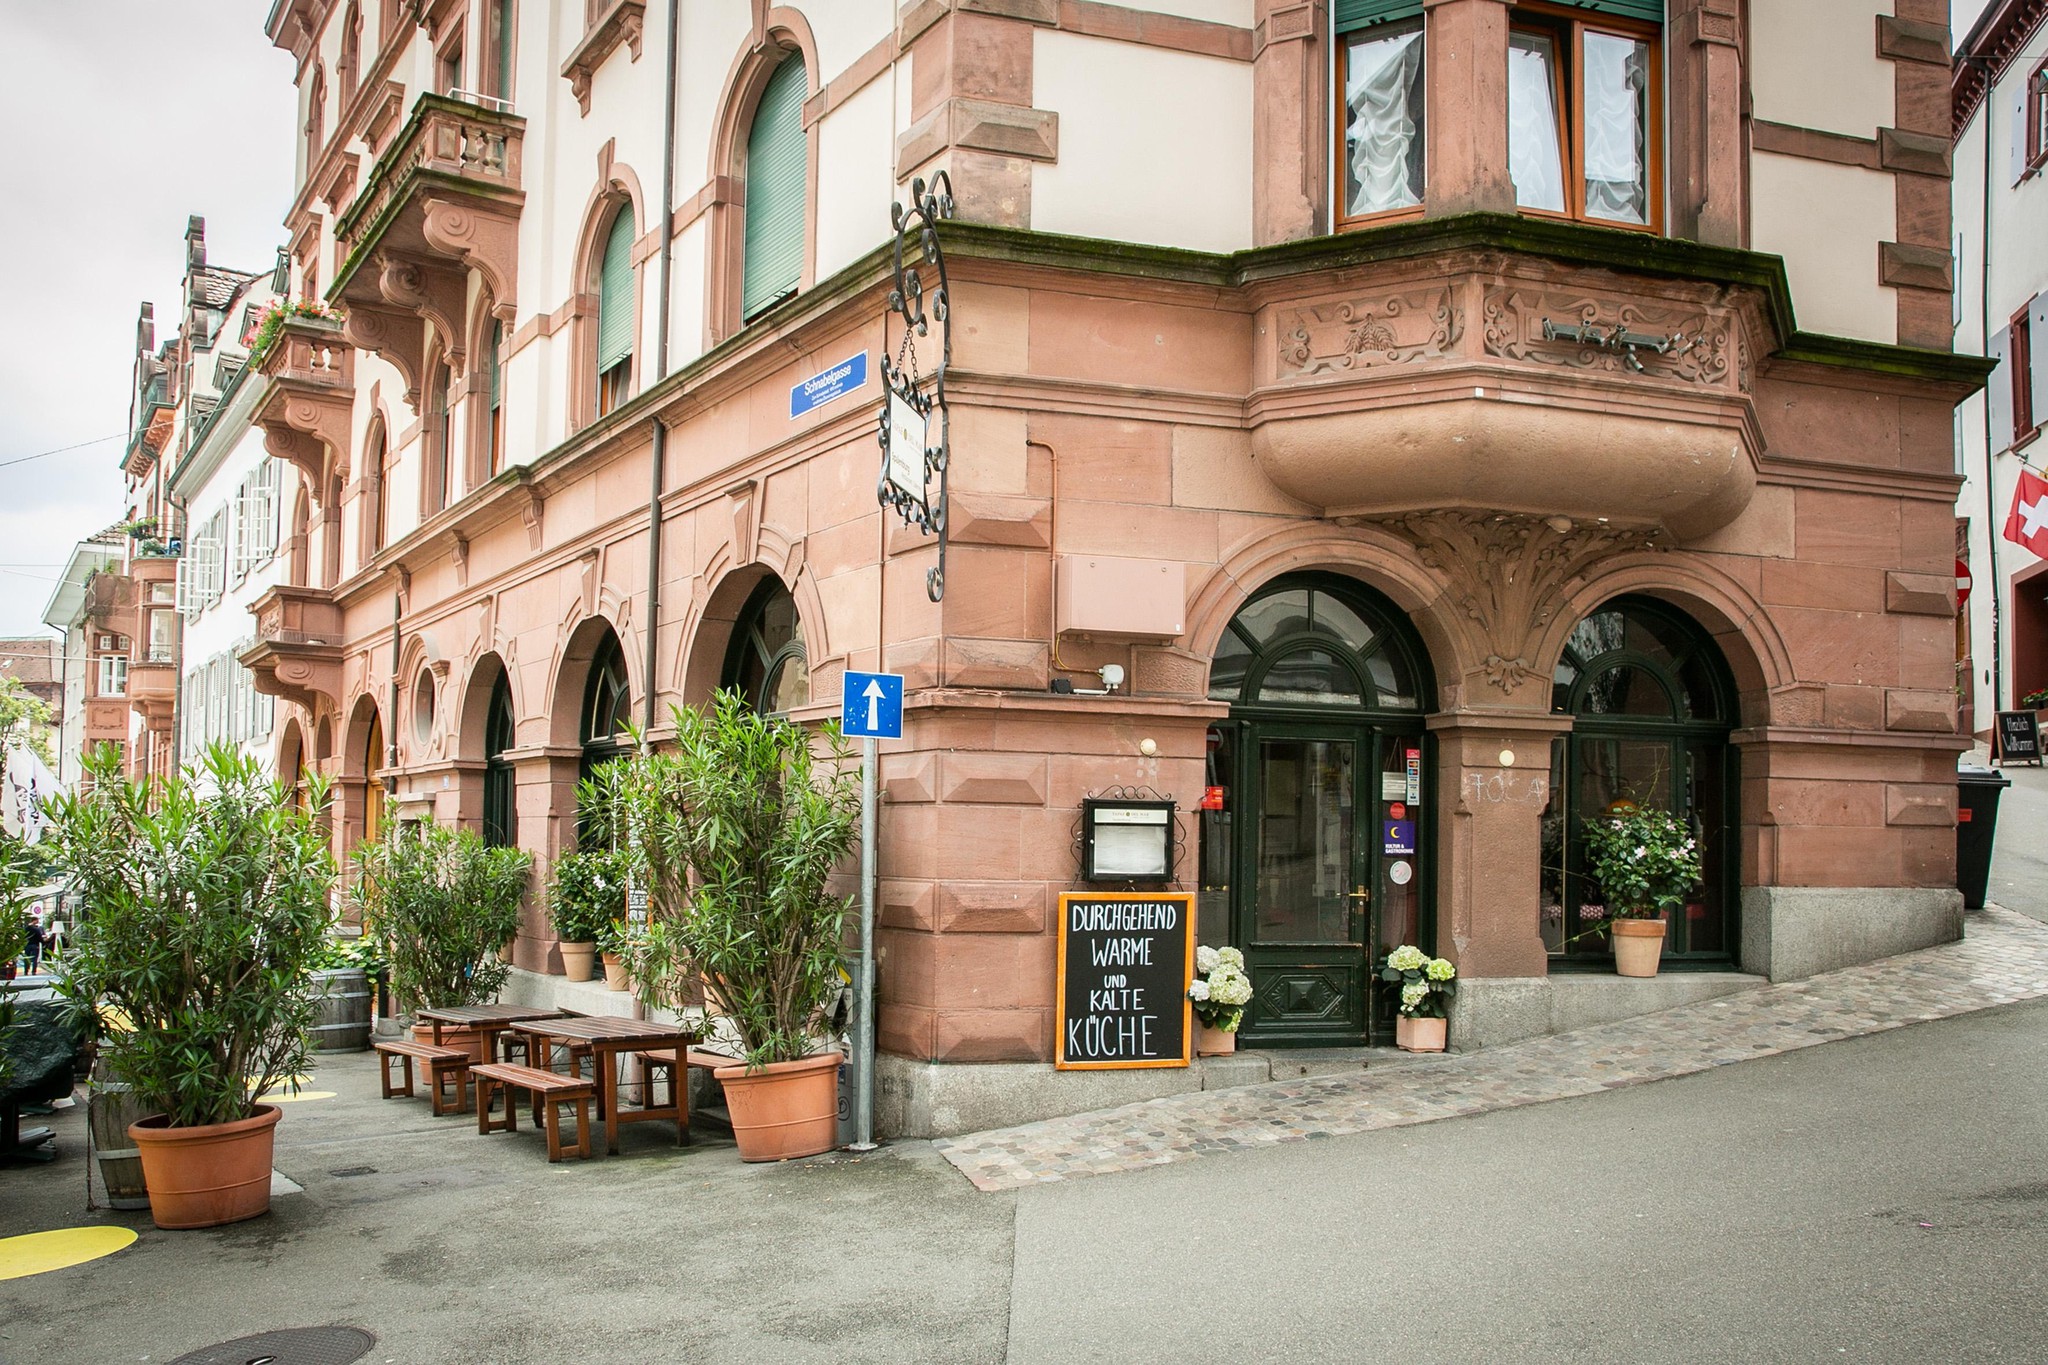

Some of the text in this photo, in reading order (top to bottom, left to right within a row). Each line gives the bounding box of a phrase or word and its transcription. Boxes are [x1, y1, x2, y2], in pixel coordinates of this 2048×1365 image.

[804, 365, 852, 396] Schnabelgasse
[1072, 904, 1177, 931] DURCHGEHEND
[1092, 937, 1154, 967] WARME
[1104, 974, 1127, 988] UND
[1090, 988, 1145, 1012] KALTE
[1069, 1015, 1158, 1057] KÜCHE
